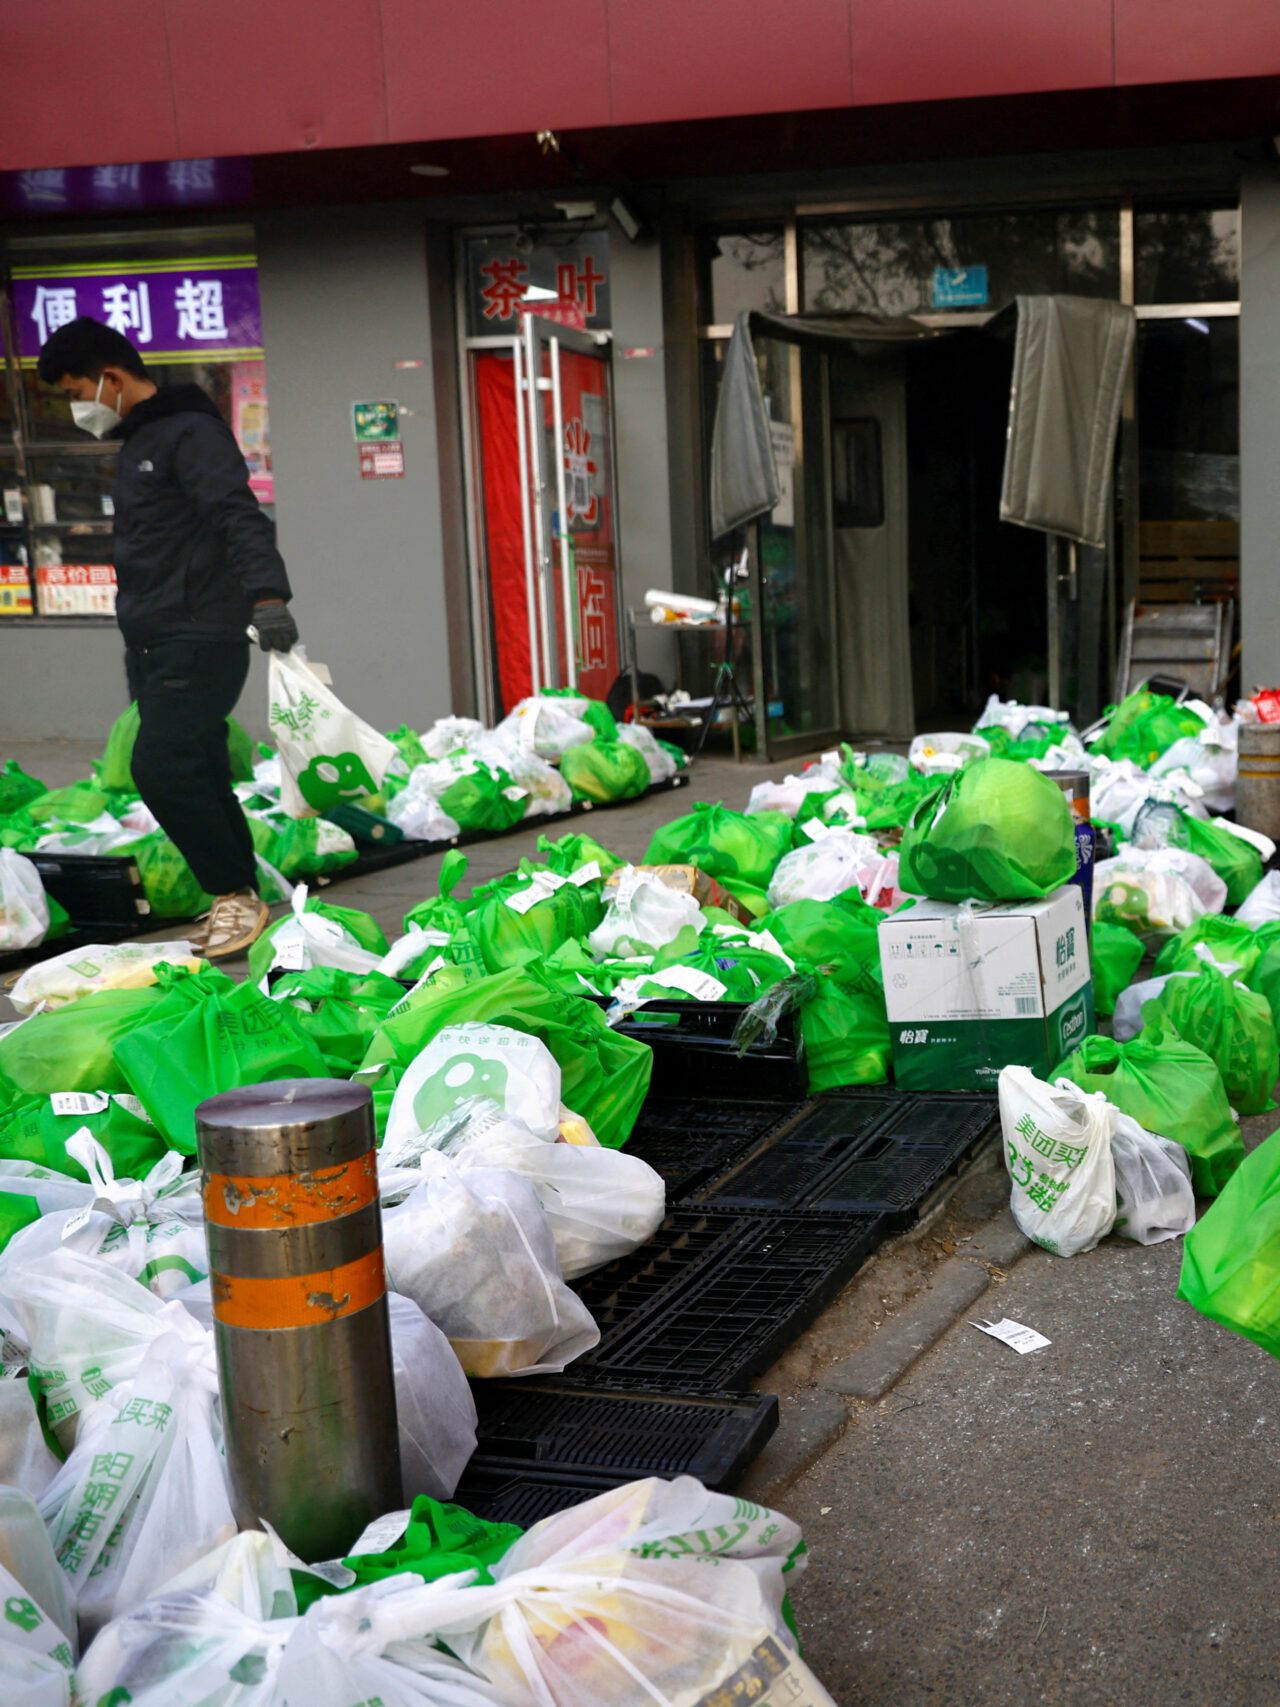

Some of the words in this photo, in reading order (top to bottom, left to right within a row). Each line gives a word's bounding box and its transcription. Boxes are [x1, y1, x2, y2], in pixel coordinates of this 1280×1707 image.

[481, 256, 606, 321] 茶叶
[31, 278, 229, 347] 便利超
[47, 565, 116, 585] 高价回
[899, 1028, 930, 1045] 怡寶
